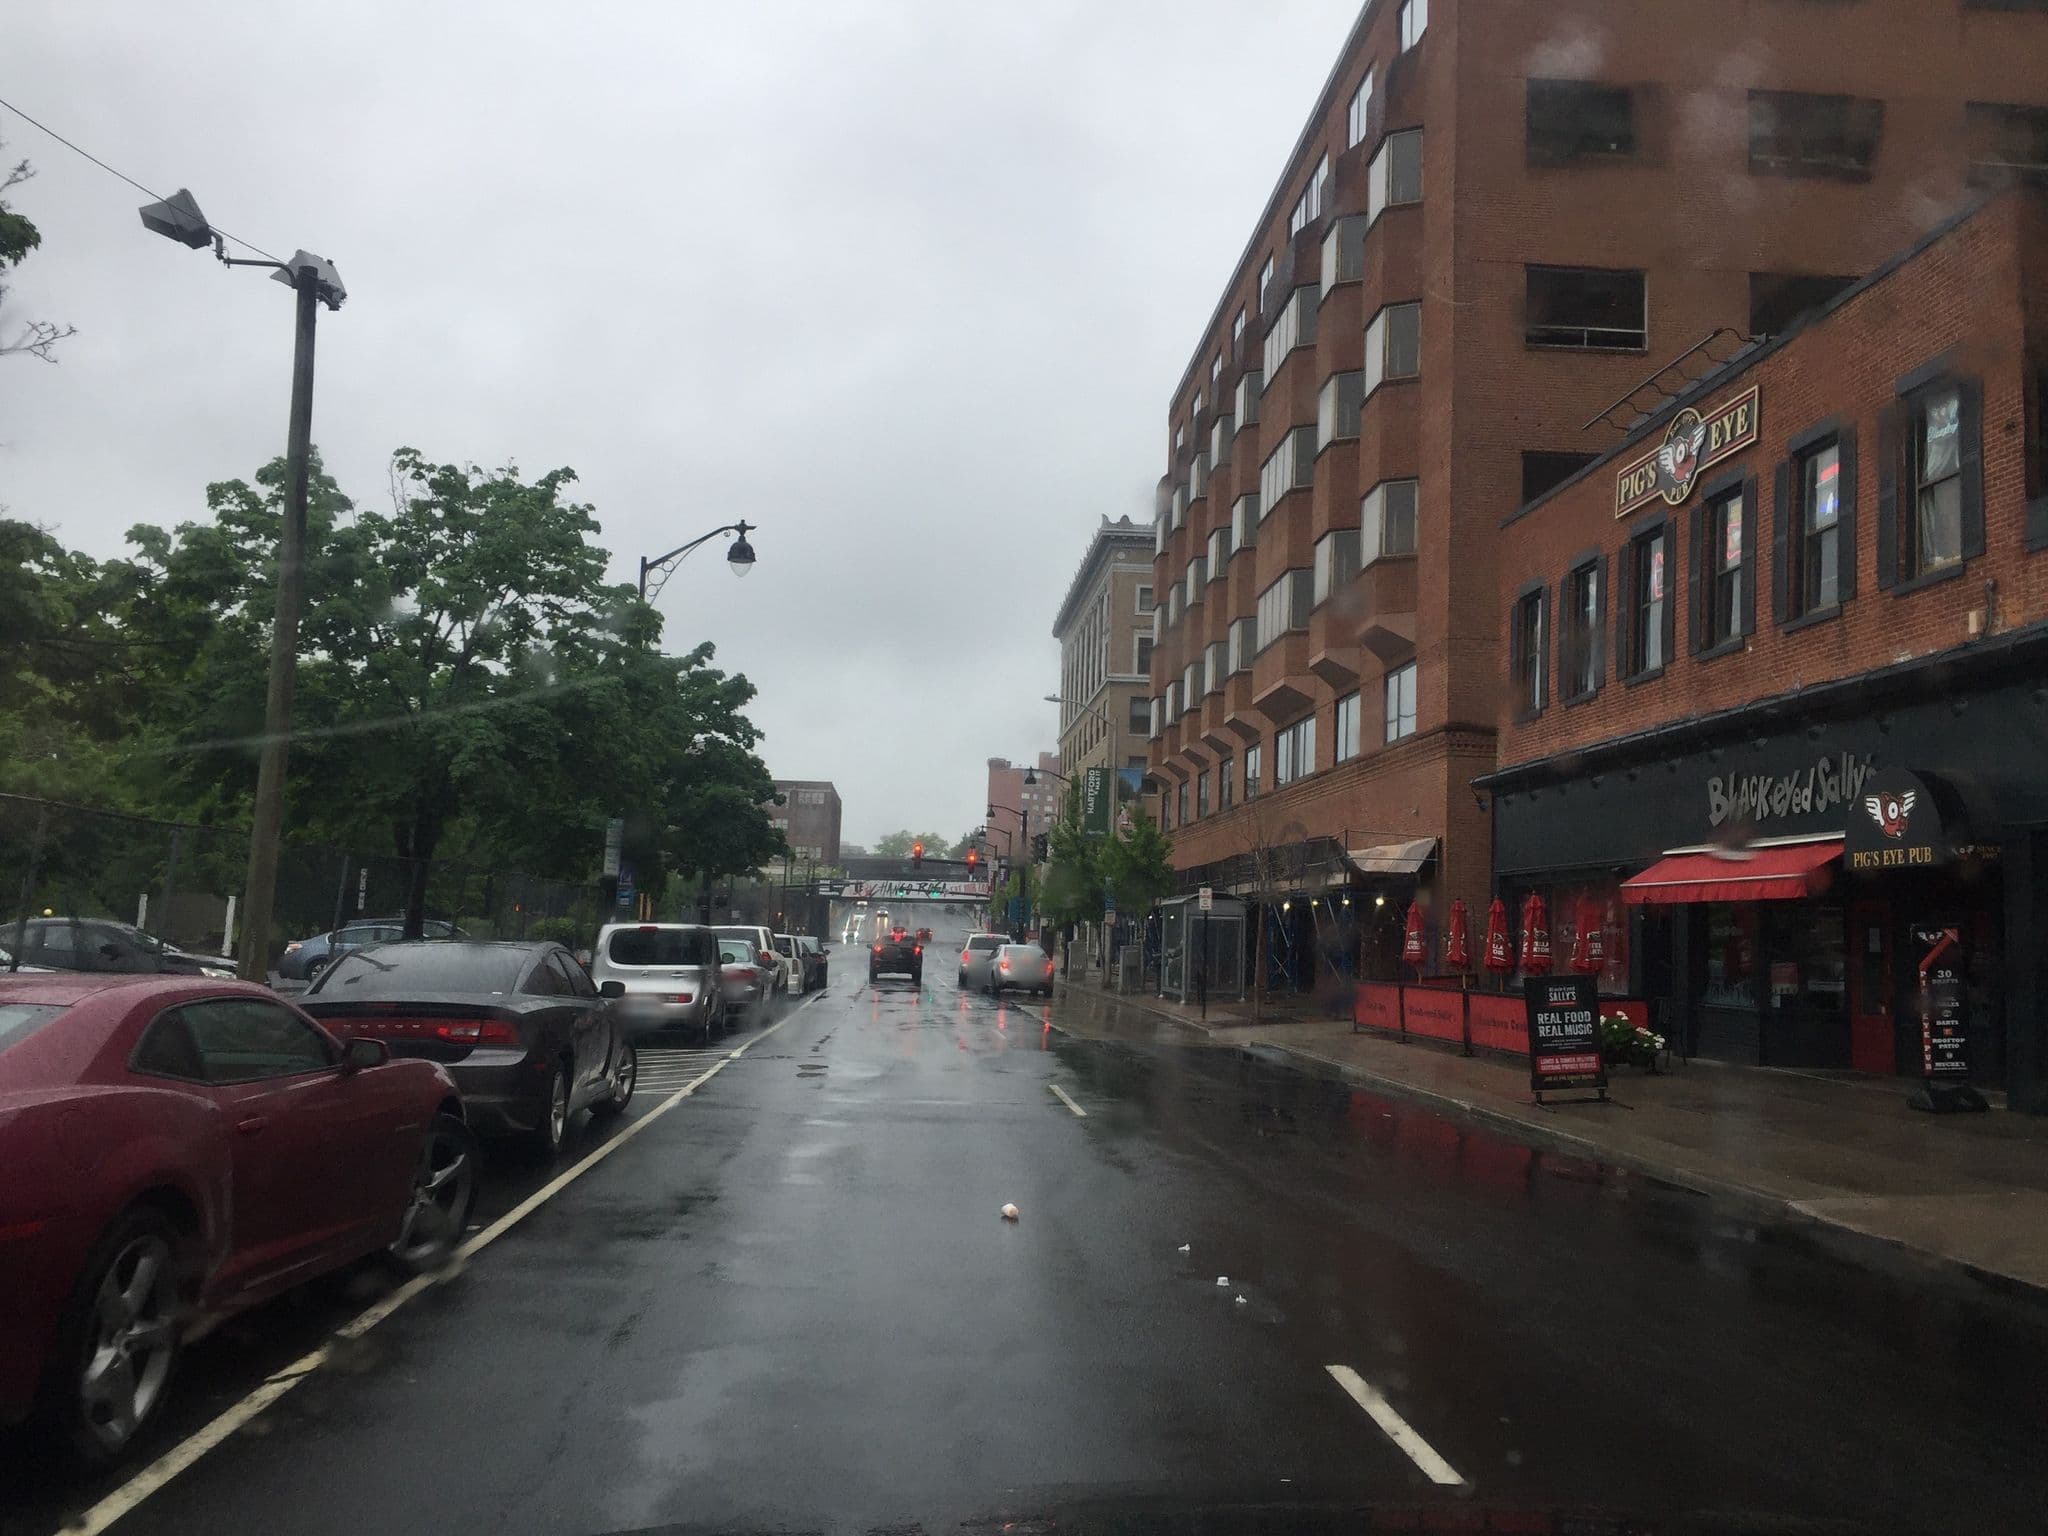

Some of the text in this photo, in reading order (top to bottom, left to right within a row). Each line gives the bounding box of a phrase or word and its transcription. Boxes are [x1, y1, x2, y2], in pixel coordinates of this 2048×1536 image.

[1619, 461, 1657, 505] PIG'S
[1710, 403, 1748, 452] EYE
[1670, 481, 1689, 501] PUB
[1087, 769, 1096, 814] HARTFORD
[1853, 847, 1933, 868] PIG'S EYE PUB
[1937, 969, 1953, 979] 30
[1548, 991, 1578, 1002] SALLY'S
[1537, 1010, 1591, 1025] REAL FOOD
[1538, 1022, 1593, 1037] REAL MUSIC
[1932, 1037, 1967, 1045] ROOFTOP
